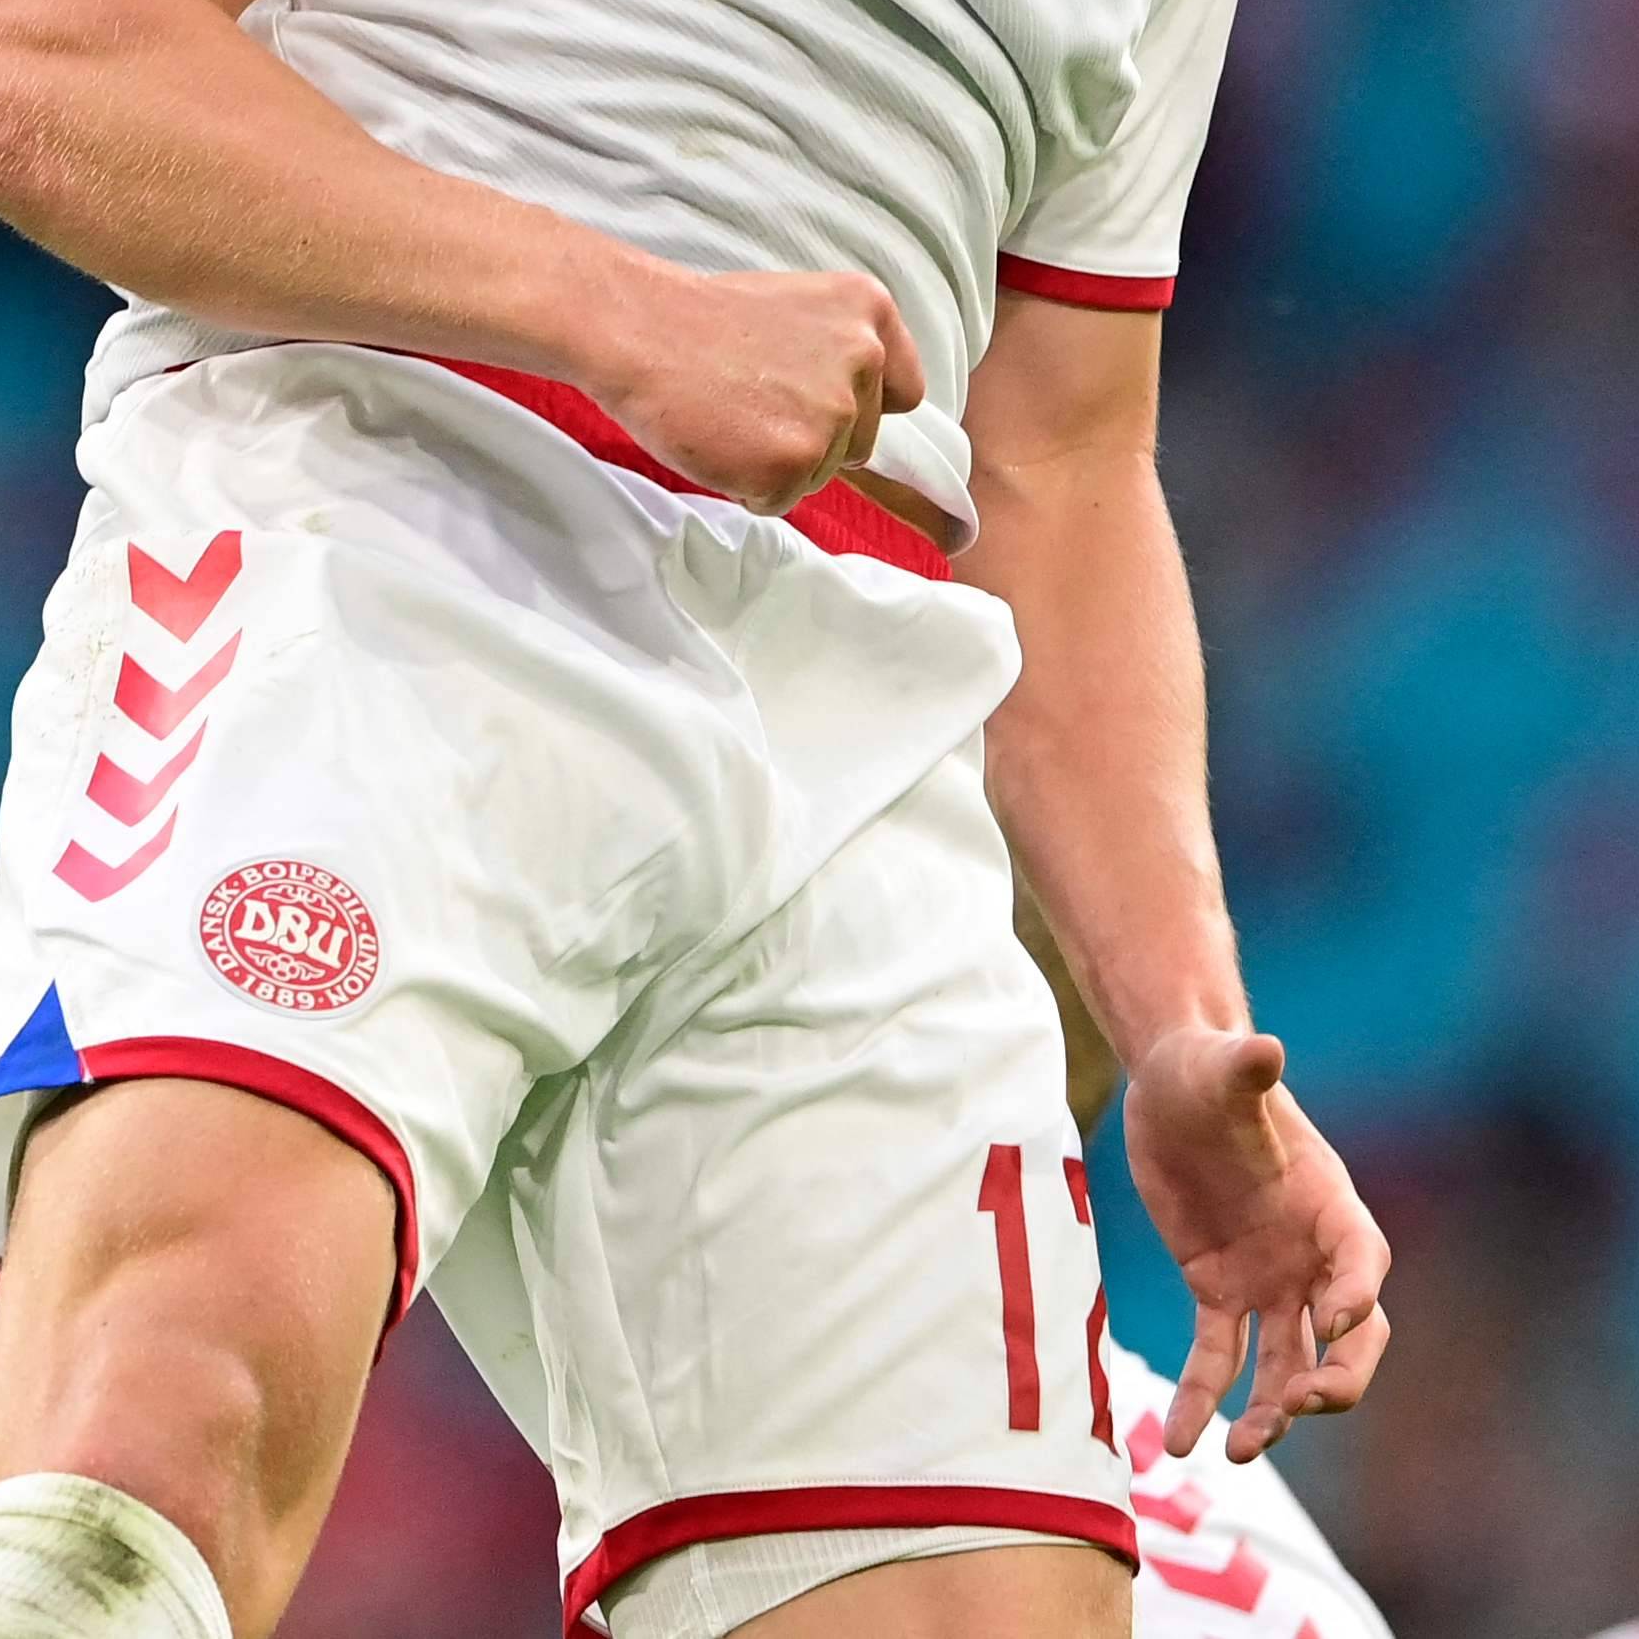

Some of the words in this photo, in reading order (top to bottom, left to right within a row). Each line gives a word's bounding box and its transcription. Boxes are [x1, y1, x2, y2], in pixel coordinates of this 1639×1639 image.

[202, 884, 241, 972] DANSK
[233, 898, 350, 969] DBU
[240, 973, 317, 1011] 1889
